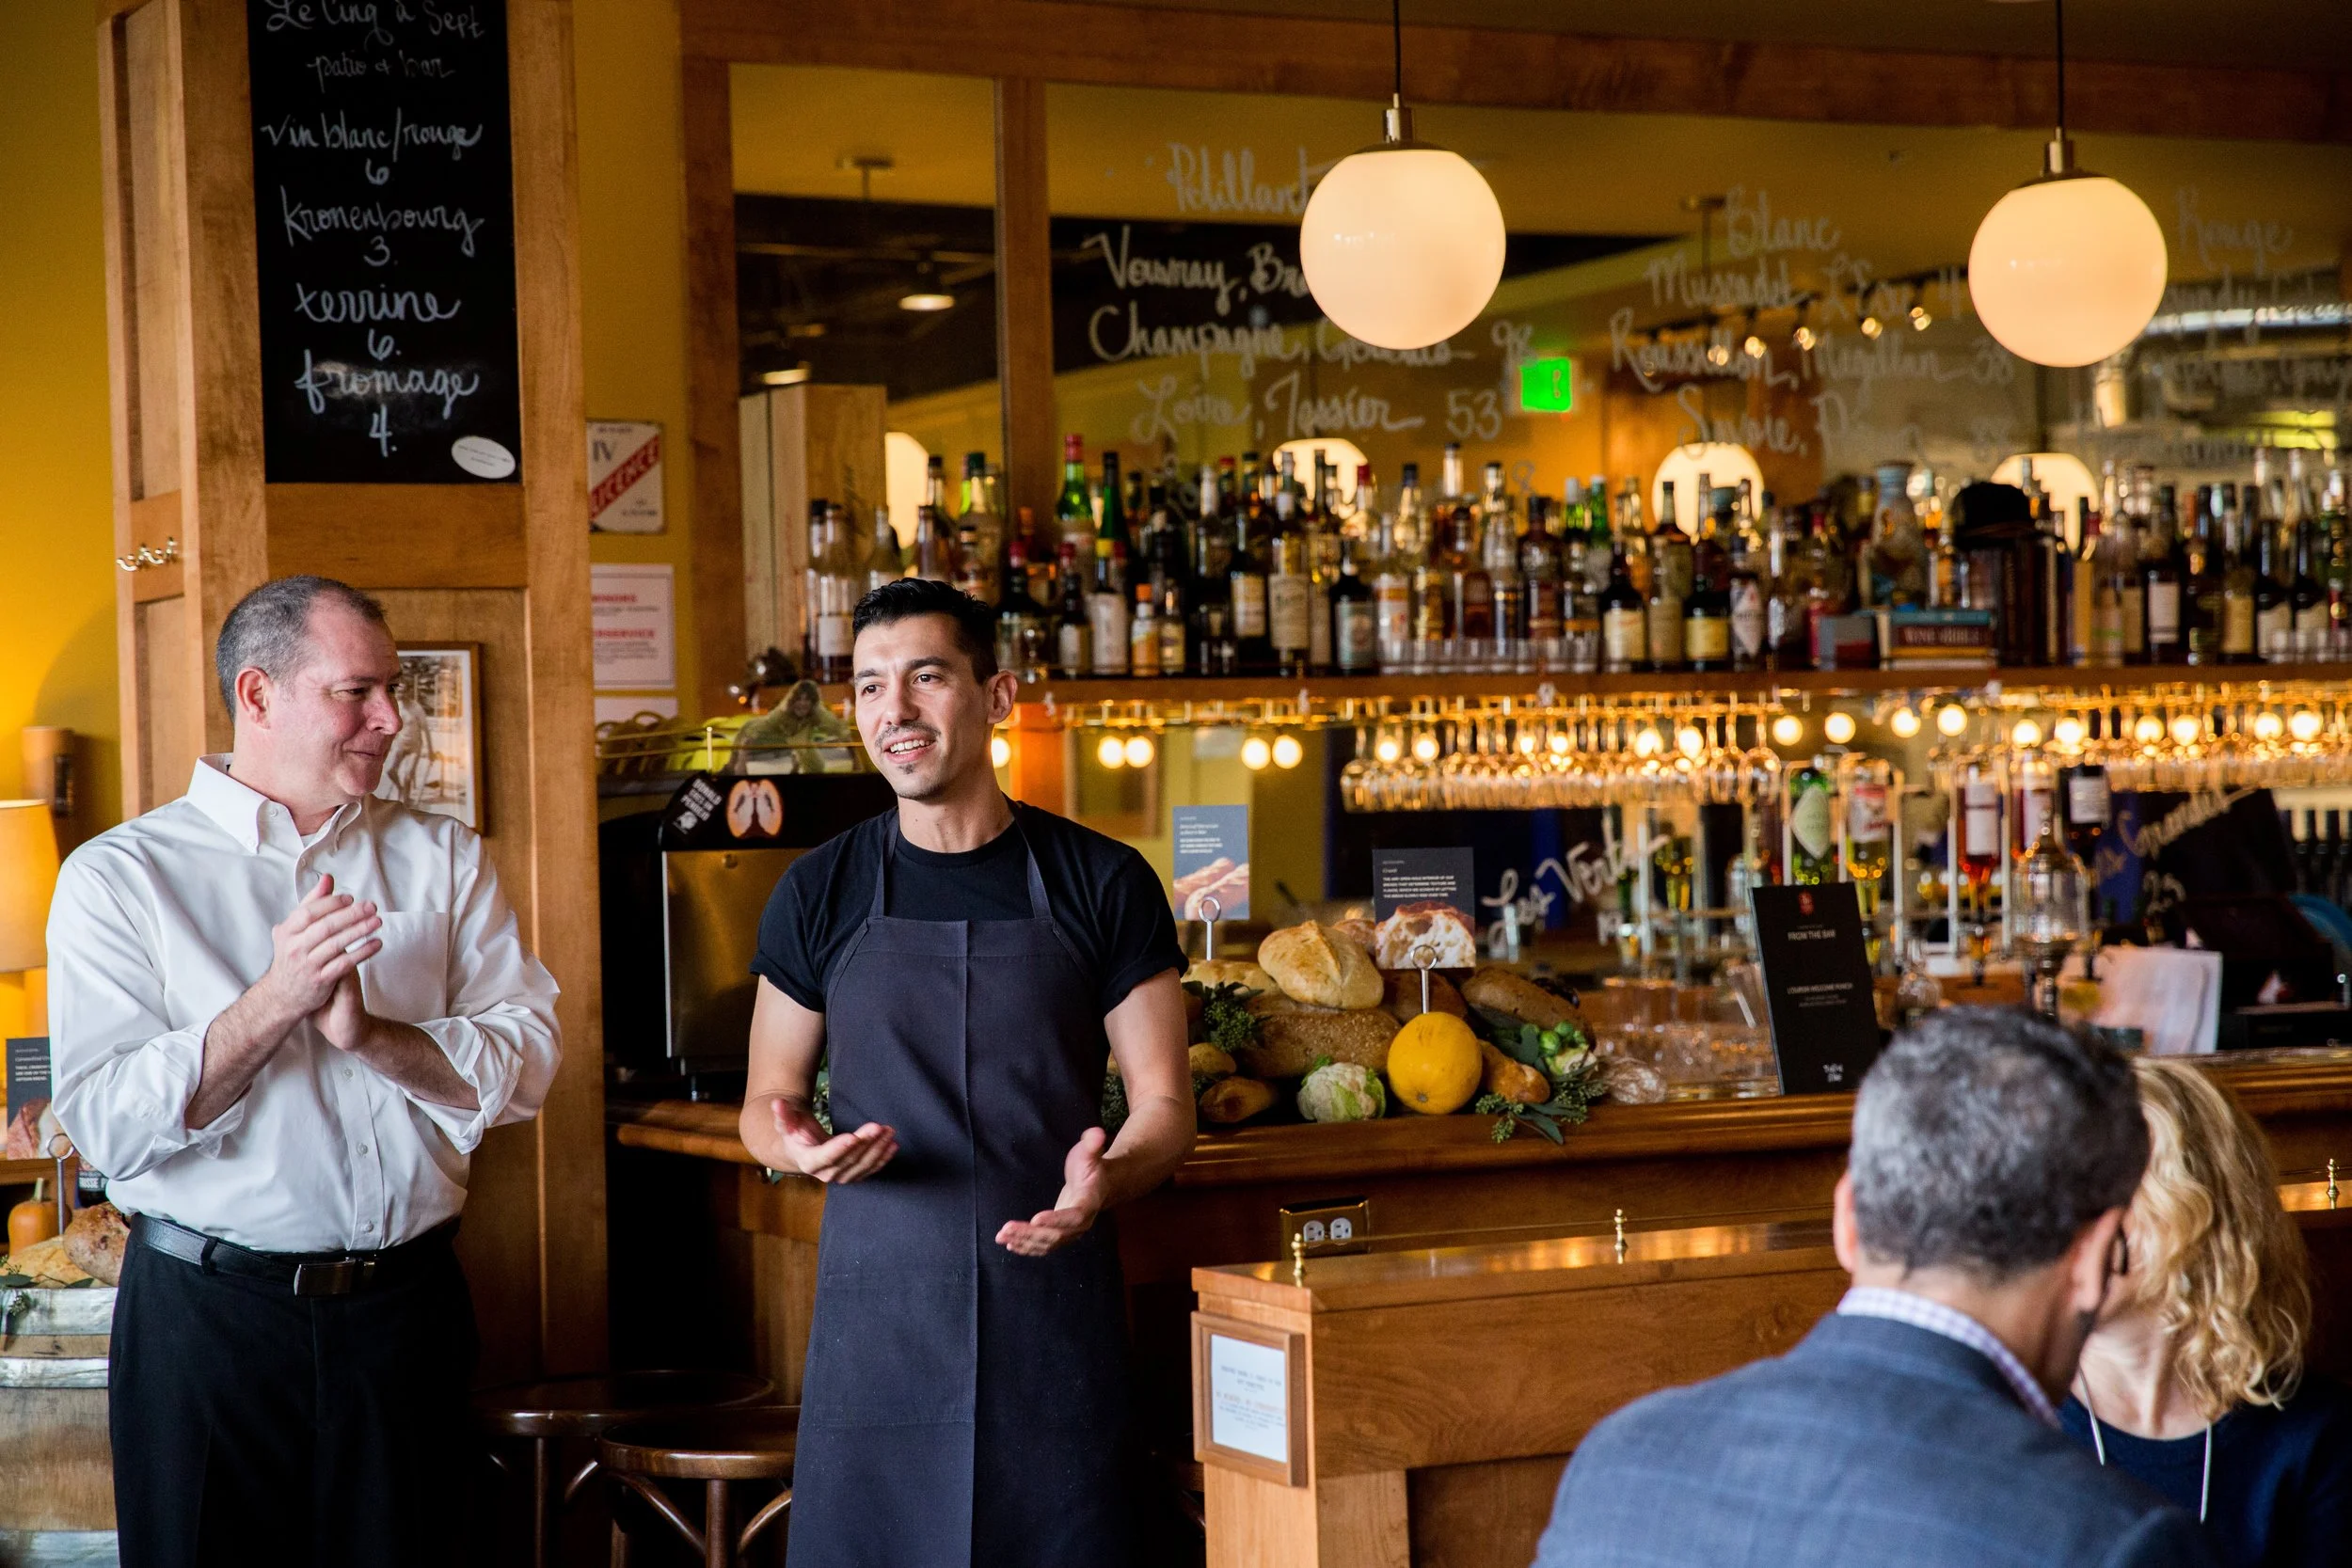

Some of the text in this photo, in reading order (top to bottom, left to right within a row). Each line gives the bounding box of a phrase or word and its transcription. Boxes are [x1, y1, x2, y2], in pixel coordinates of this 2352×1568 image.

[424, 0, 485, 38] Sept
[307, 51, 366, 93] patio
[399, 49, 455, 78] bar
[260, 114, 319, 148] Vin
[365, 158, 389, 185] 6
[1725, 188, 1842, 258] Blanc
[294, 282, 461, 323] terrine
[294, 349, 479, 420] fromage
[1446, 388, 1502, 441] 53
[1788, 931, 1807, 941] FROM
[1808, 930, 1821, 940] THE
